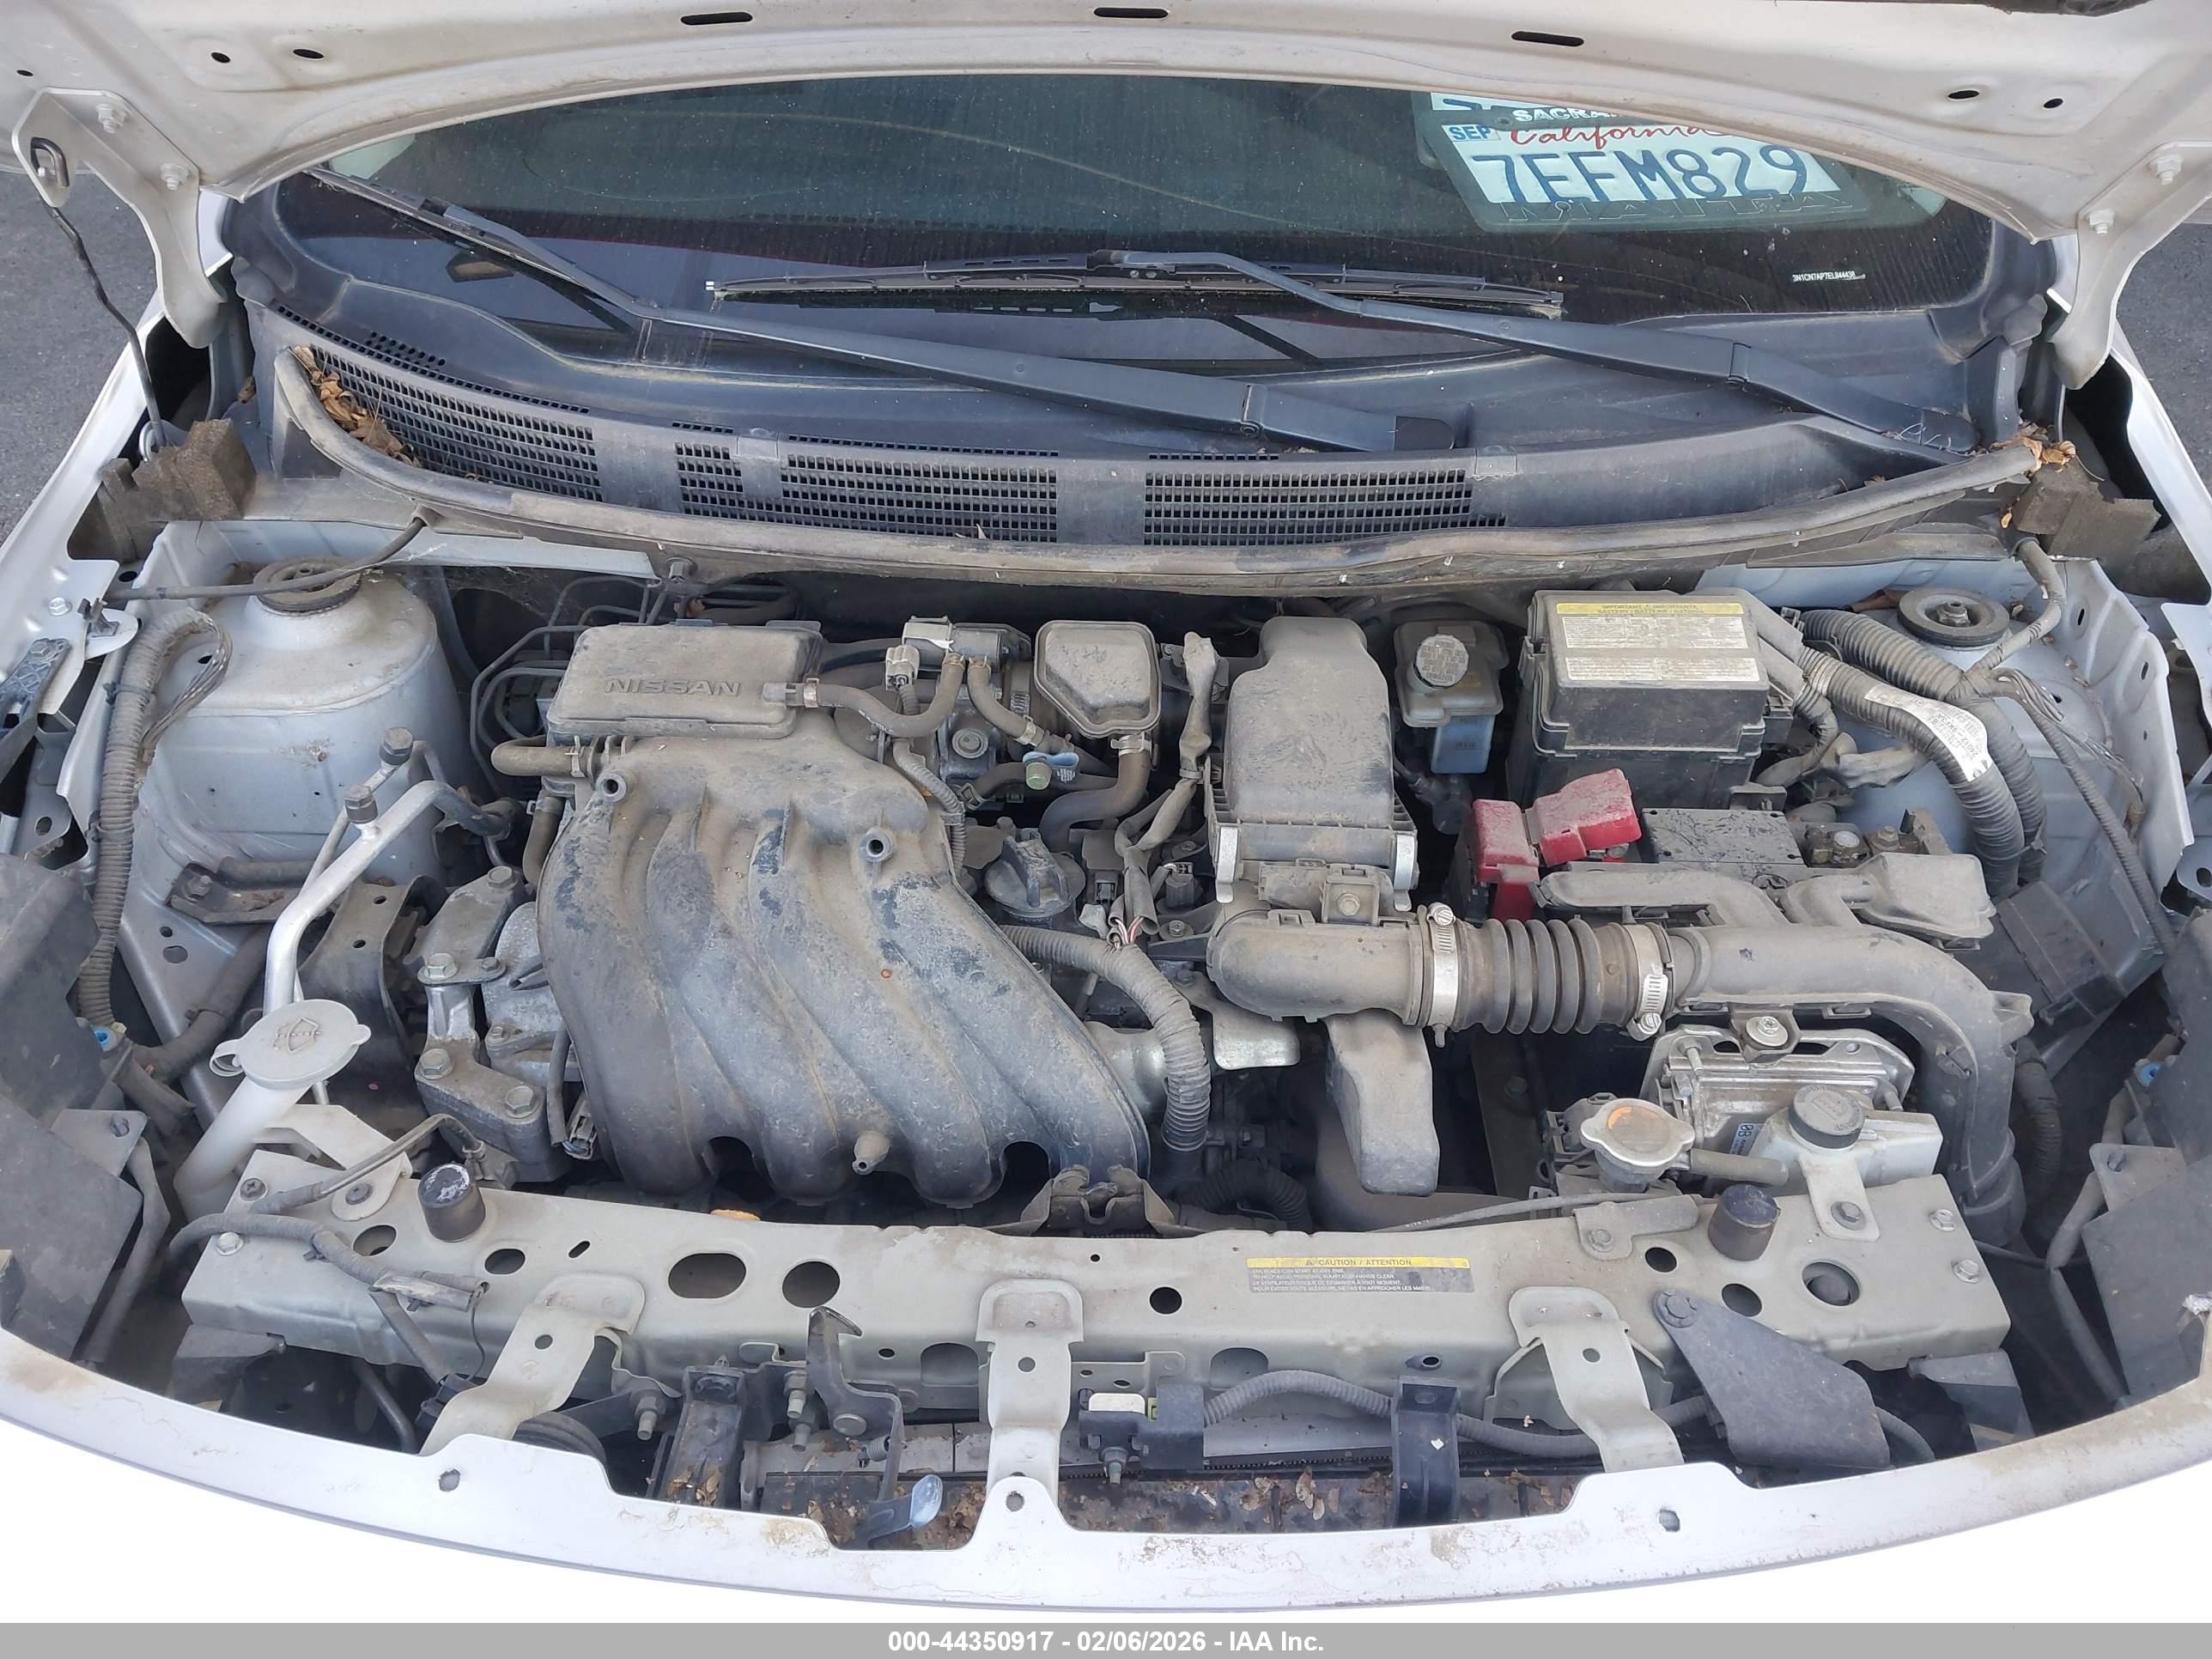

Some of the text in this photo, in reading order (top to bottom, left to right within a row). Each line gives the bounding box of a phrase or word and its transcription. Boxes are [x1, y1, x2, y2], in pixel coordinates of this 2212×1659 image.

[1448, 125, 1492, 141] SEP
[1511, 125, 1732, 150] California
[1472, 144, 1808, 203] 7EFM829
[605, 679, 740, 697] NISSAN
